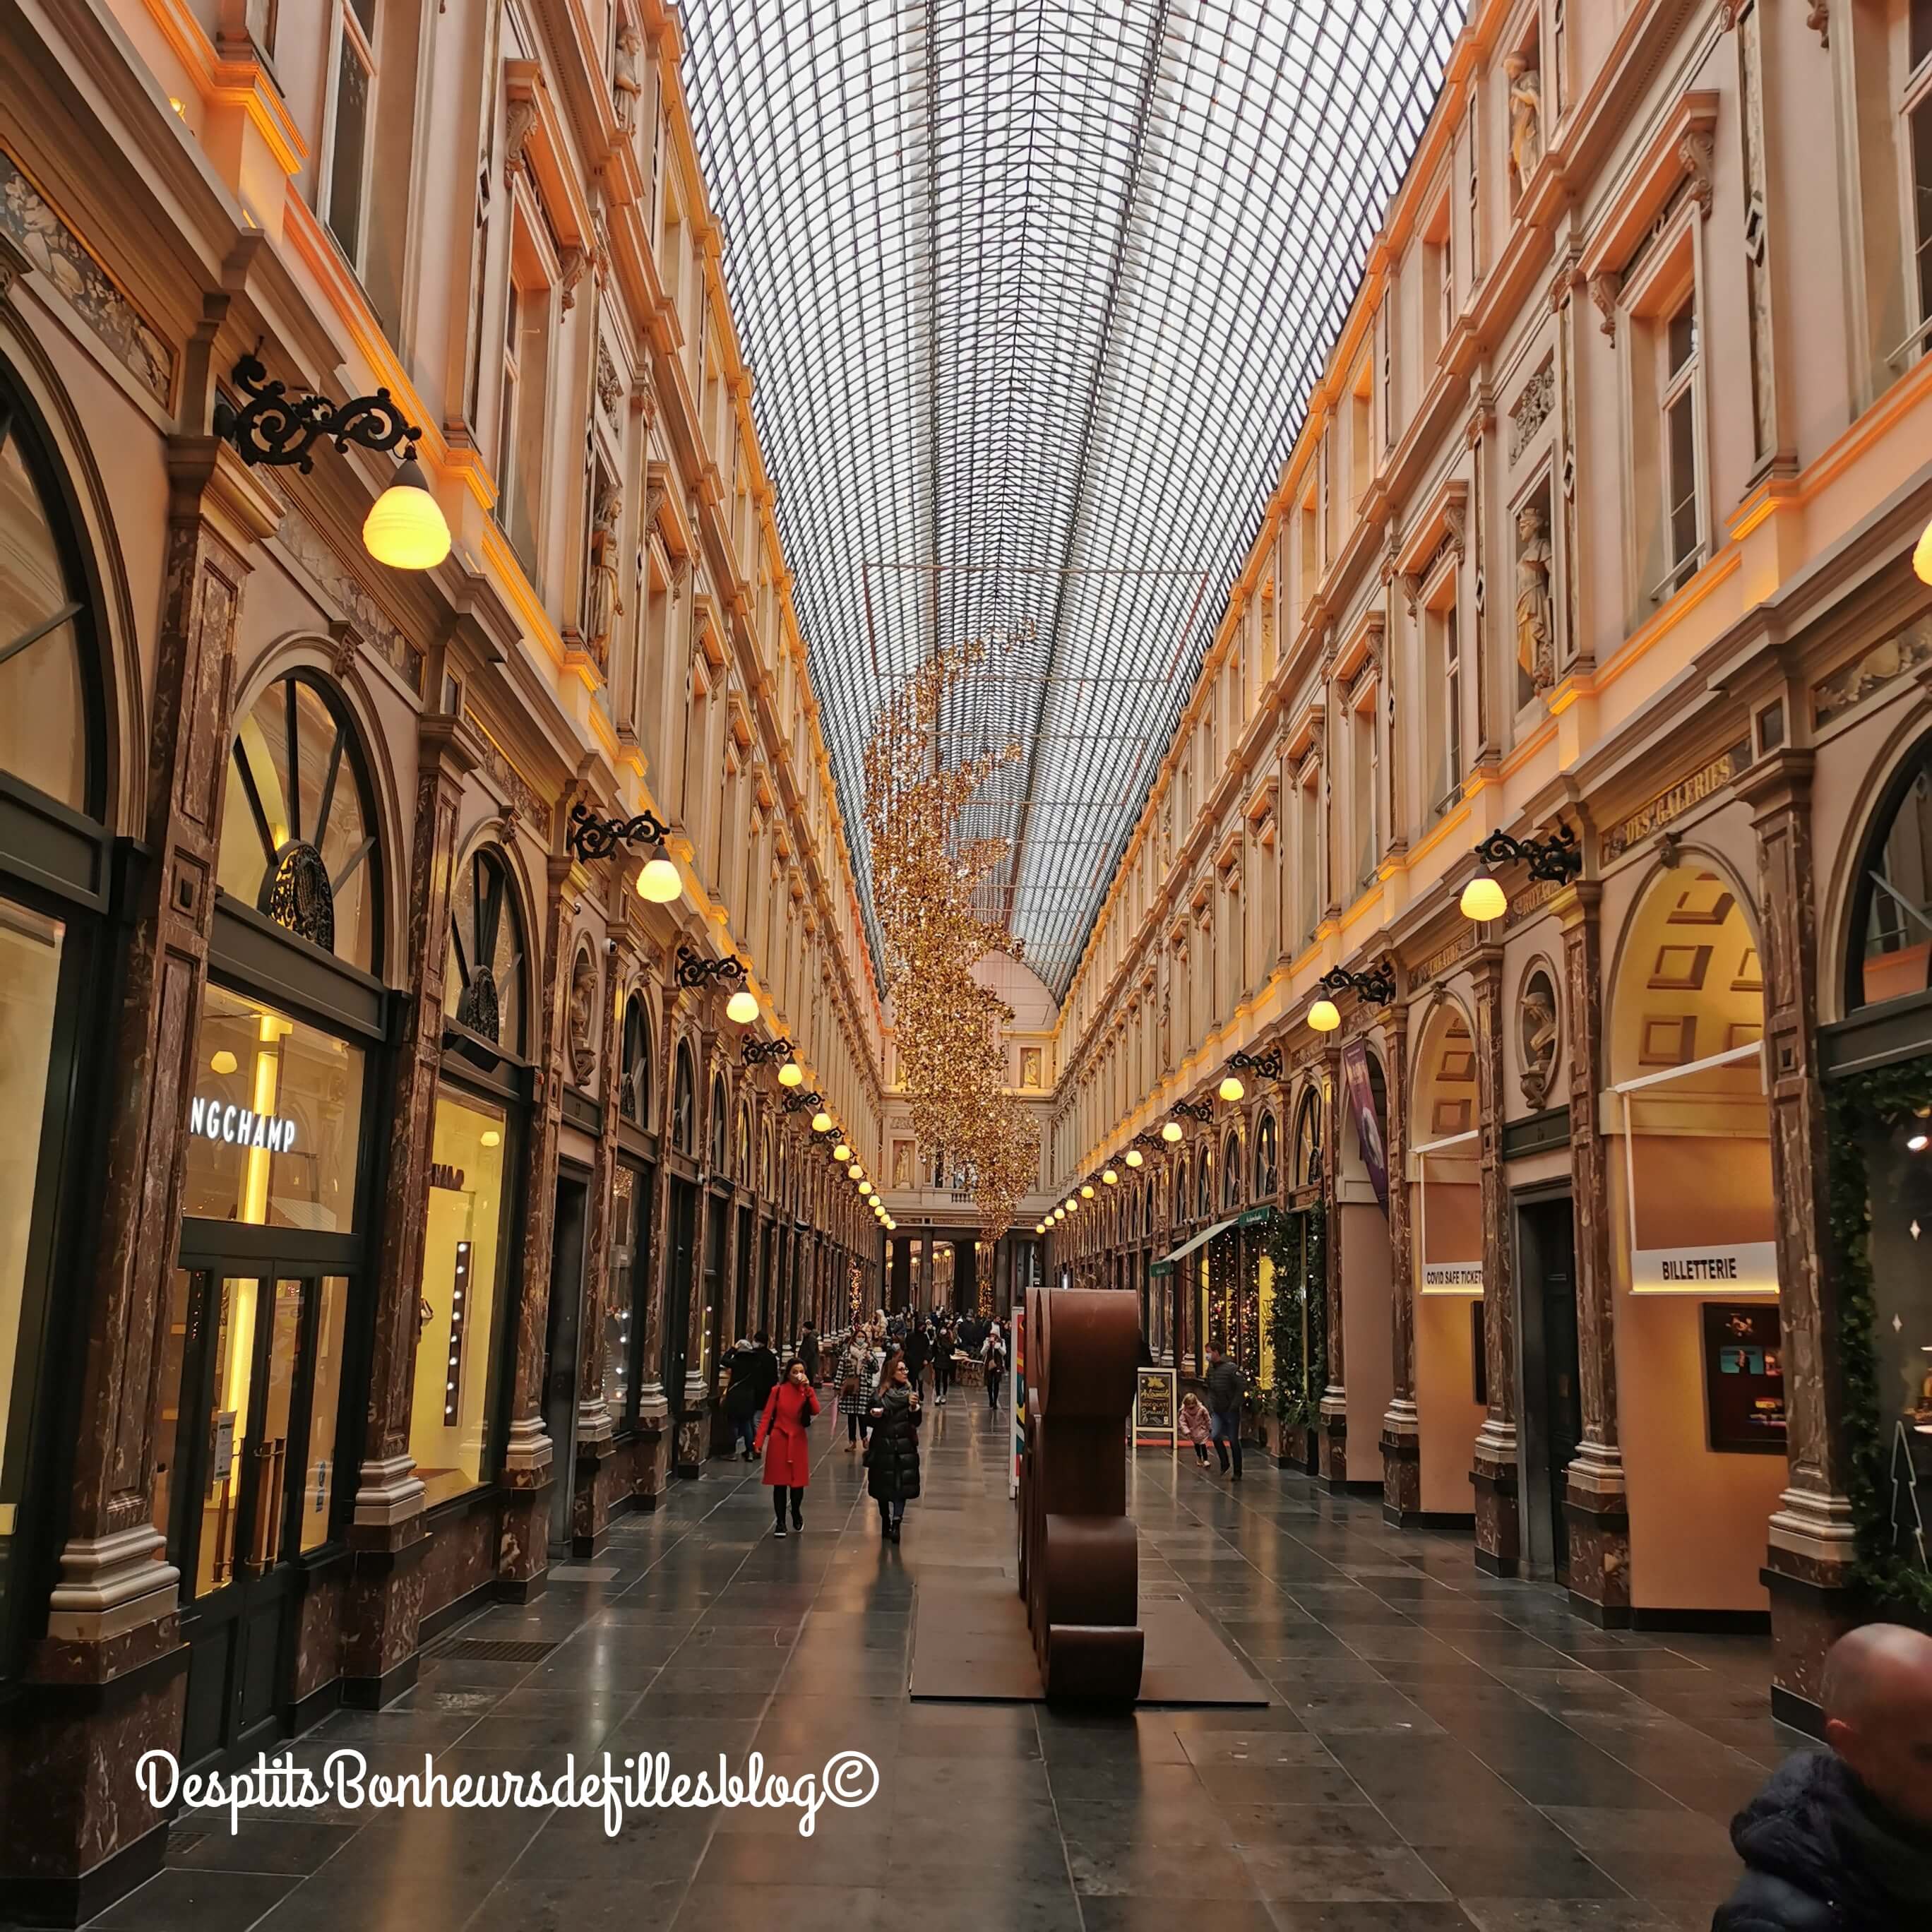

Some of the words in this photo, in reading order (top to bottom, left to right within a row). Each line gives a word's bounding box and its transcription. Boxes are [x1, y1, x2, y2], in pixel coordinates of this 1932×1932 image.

[1626, 809, 1651, 846] DES
[1656, 753, 1731, 825] GALERIES
[190, 1096, 295, 1153] NGCHAMP
[1427, 1271, 1444, 1284] COVID
[1445, 1270, 1460, 1284] SAFE
[1662, 1258, 1737, 1280] BILLETTERIE
